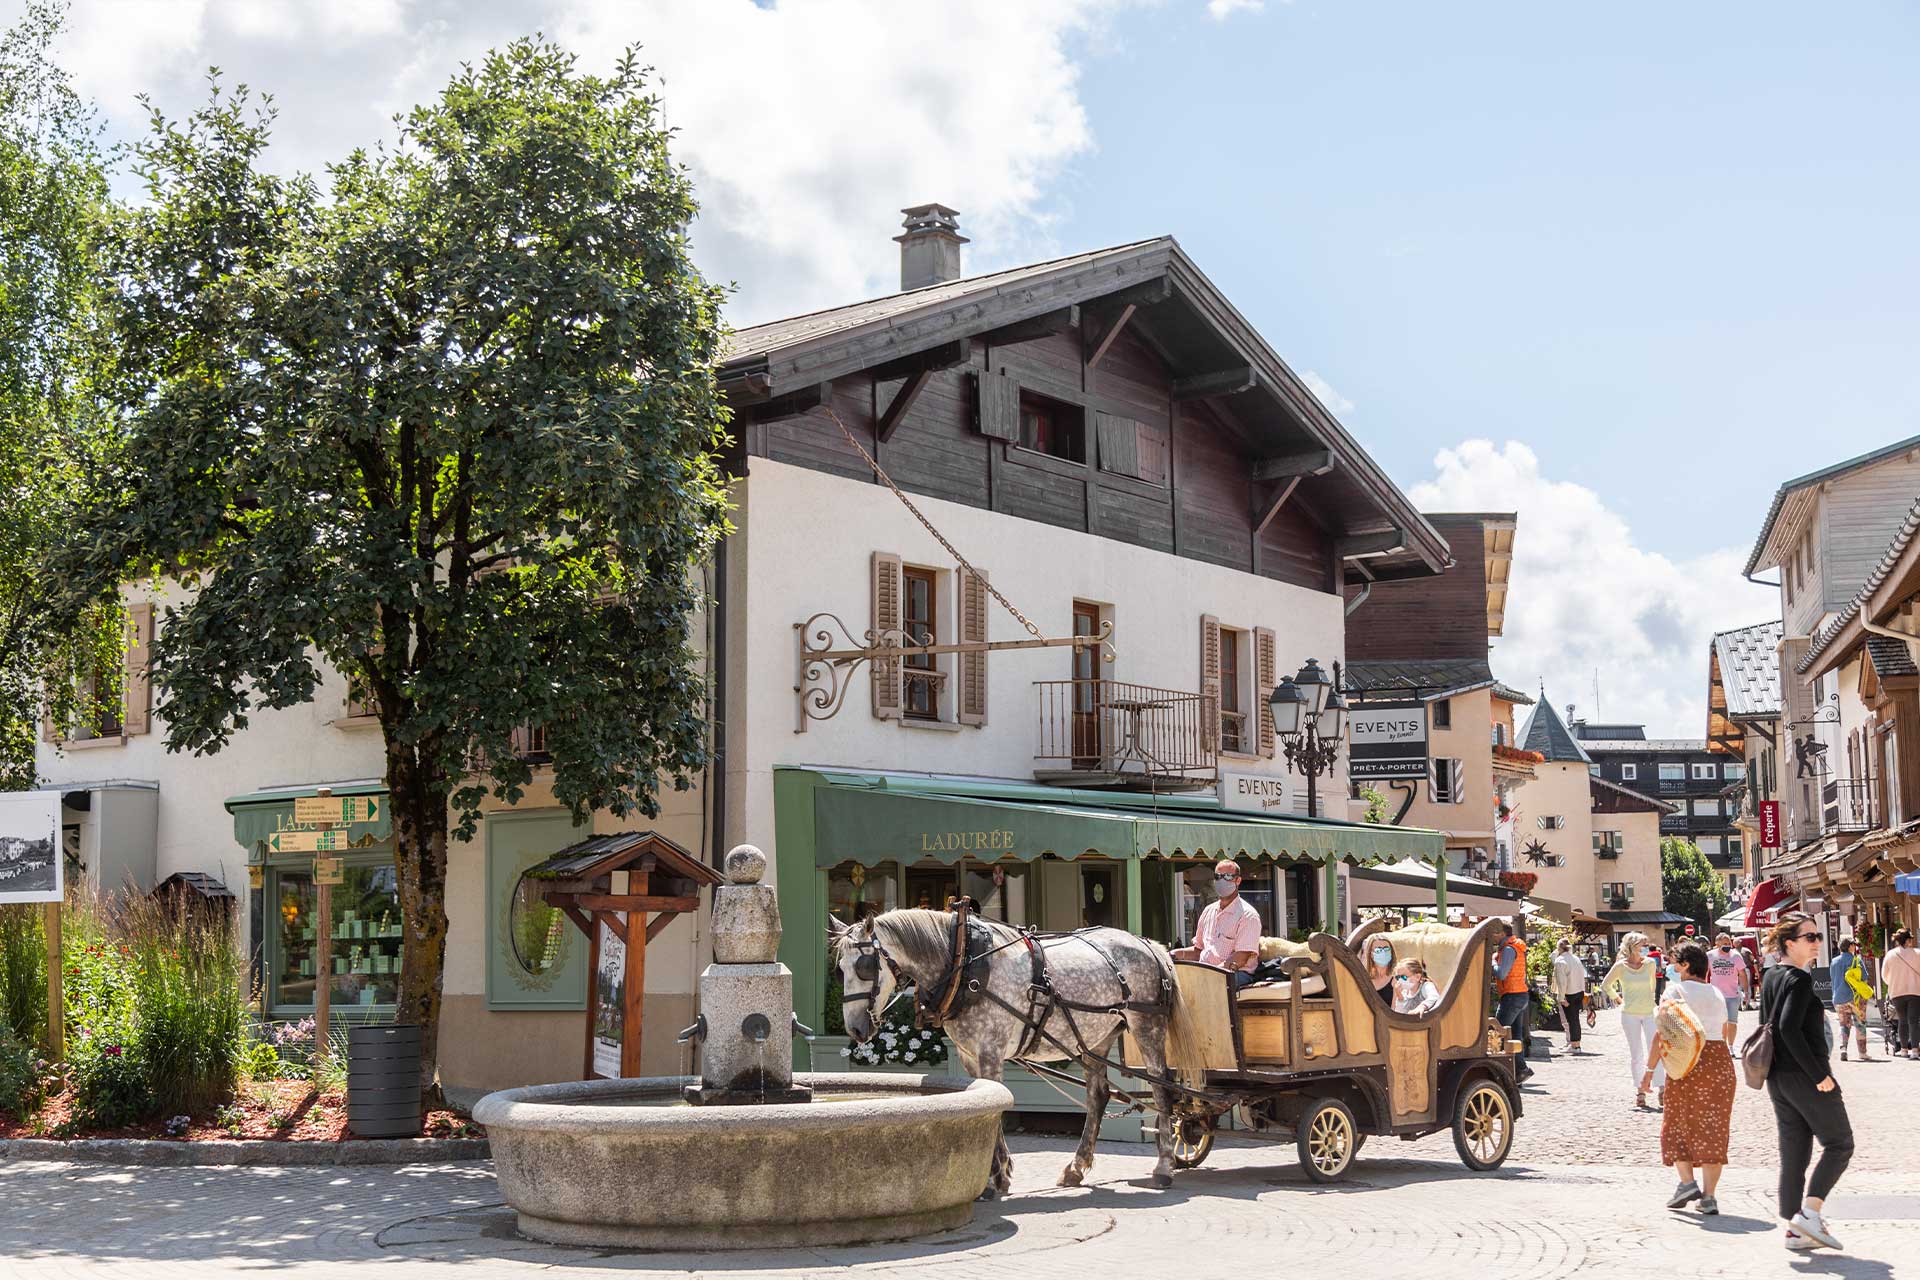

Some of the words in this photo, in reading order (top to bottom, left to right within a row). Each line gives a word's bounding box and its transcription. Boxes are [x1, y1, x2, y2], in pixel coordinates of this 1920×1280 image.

[1355, 720, 1419, 734] EVENTS
[1238, 778, 1283, 797] EVENTS
[1764, 804, 1776, 844] Crêperie
[921, 829, 1015, 851] LADURÉE
